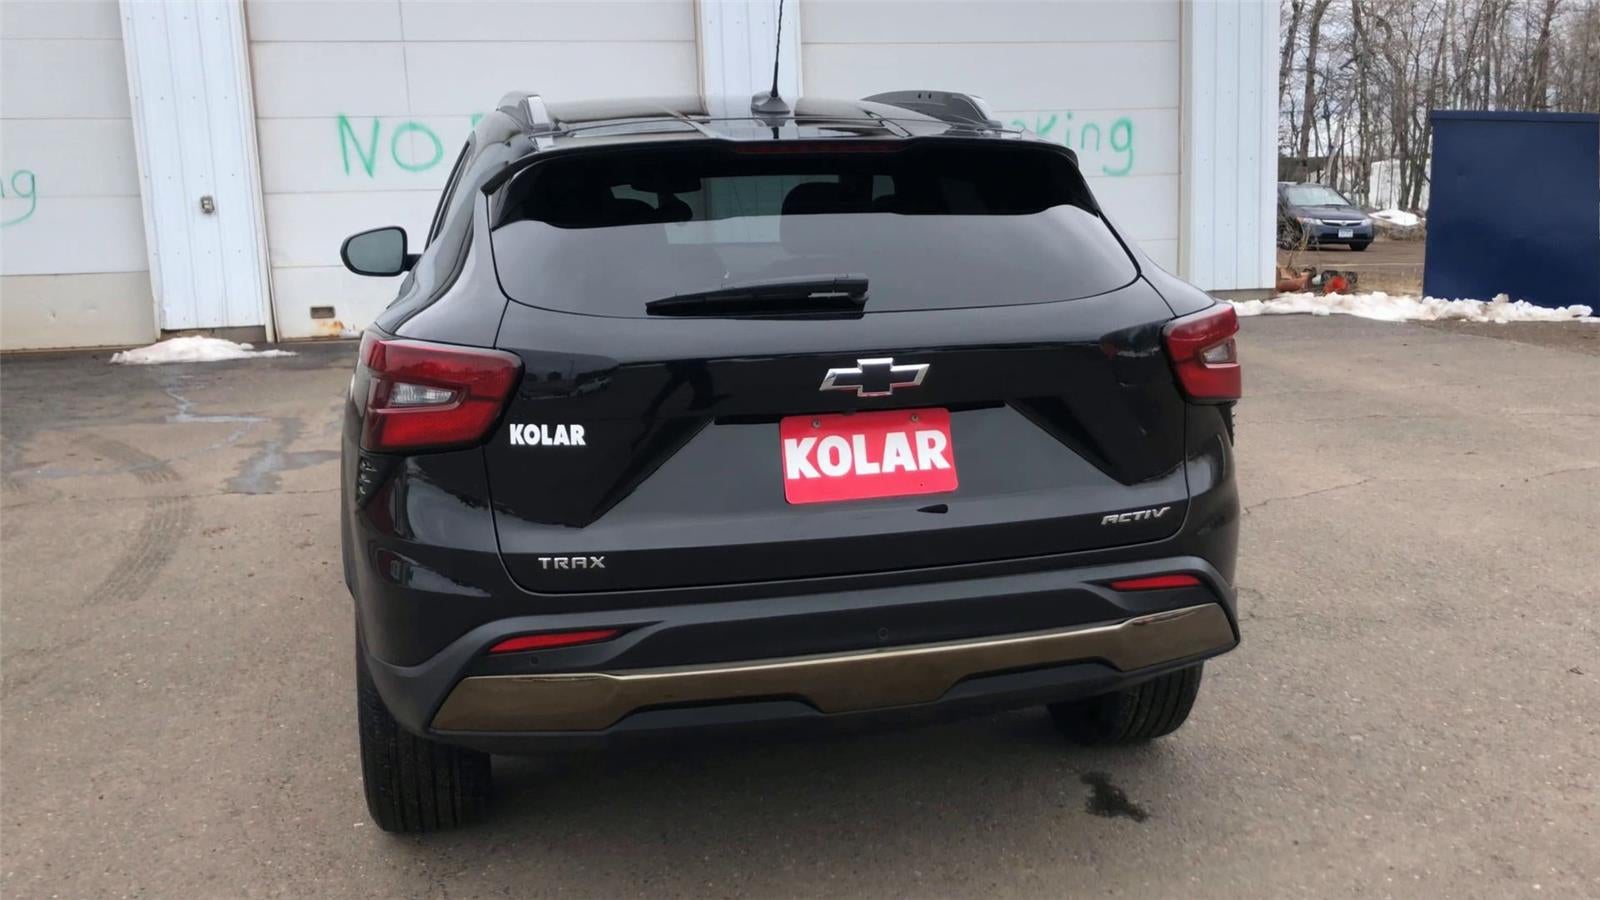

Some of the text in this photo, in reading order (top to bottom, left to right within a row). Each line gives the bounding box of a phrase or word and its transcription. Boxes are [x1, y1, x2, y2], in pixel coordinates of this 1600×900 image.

[509, 423, 586, 446] KOLAR
[784, 429, 951, 480] KOLAR
[1100, 506, 1171, 525] ACTIV
[538, 556, 605, 569] TRAX
